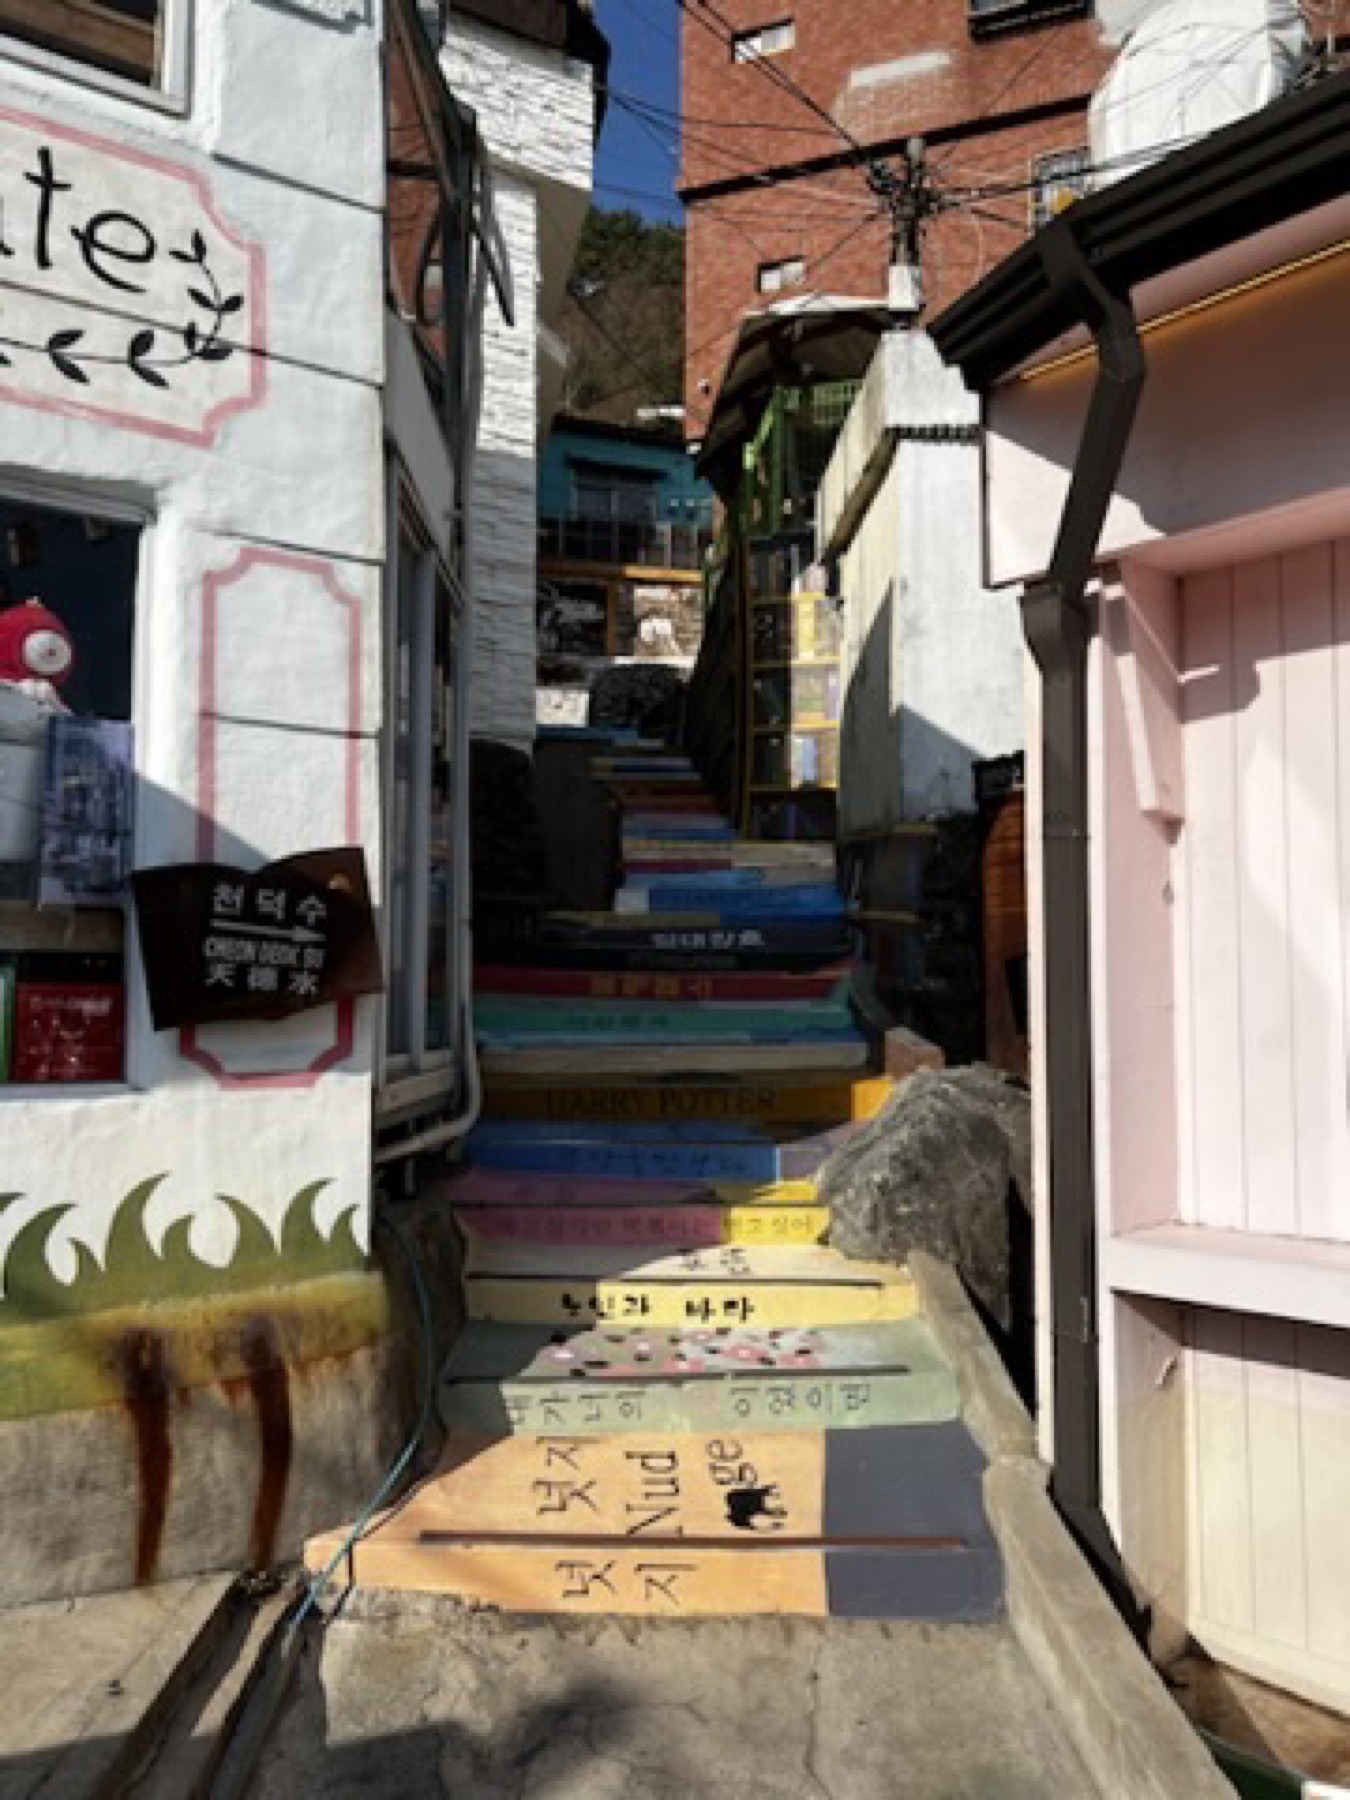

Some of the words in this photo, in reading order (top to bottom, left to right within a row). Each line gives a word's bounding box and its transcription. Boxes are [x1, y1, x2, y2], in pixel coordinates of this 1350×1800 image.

[0, 146, 156, 295] te
[659, 1087, 777, 1114] POTTER
[561, 1293, 651, 1321] 노인과
[685, 1296, 755, 1325] 바다
